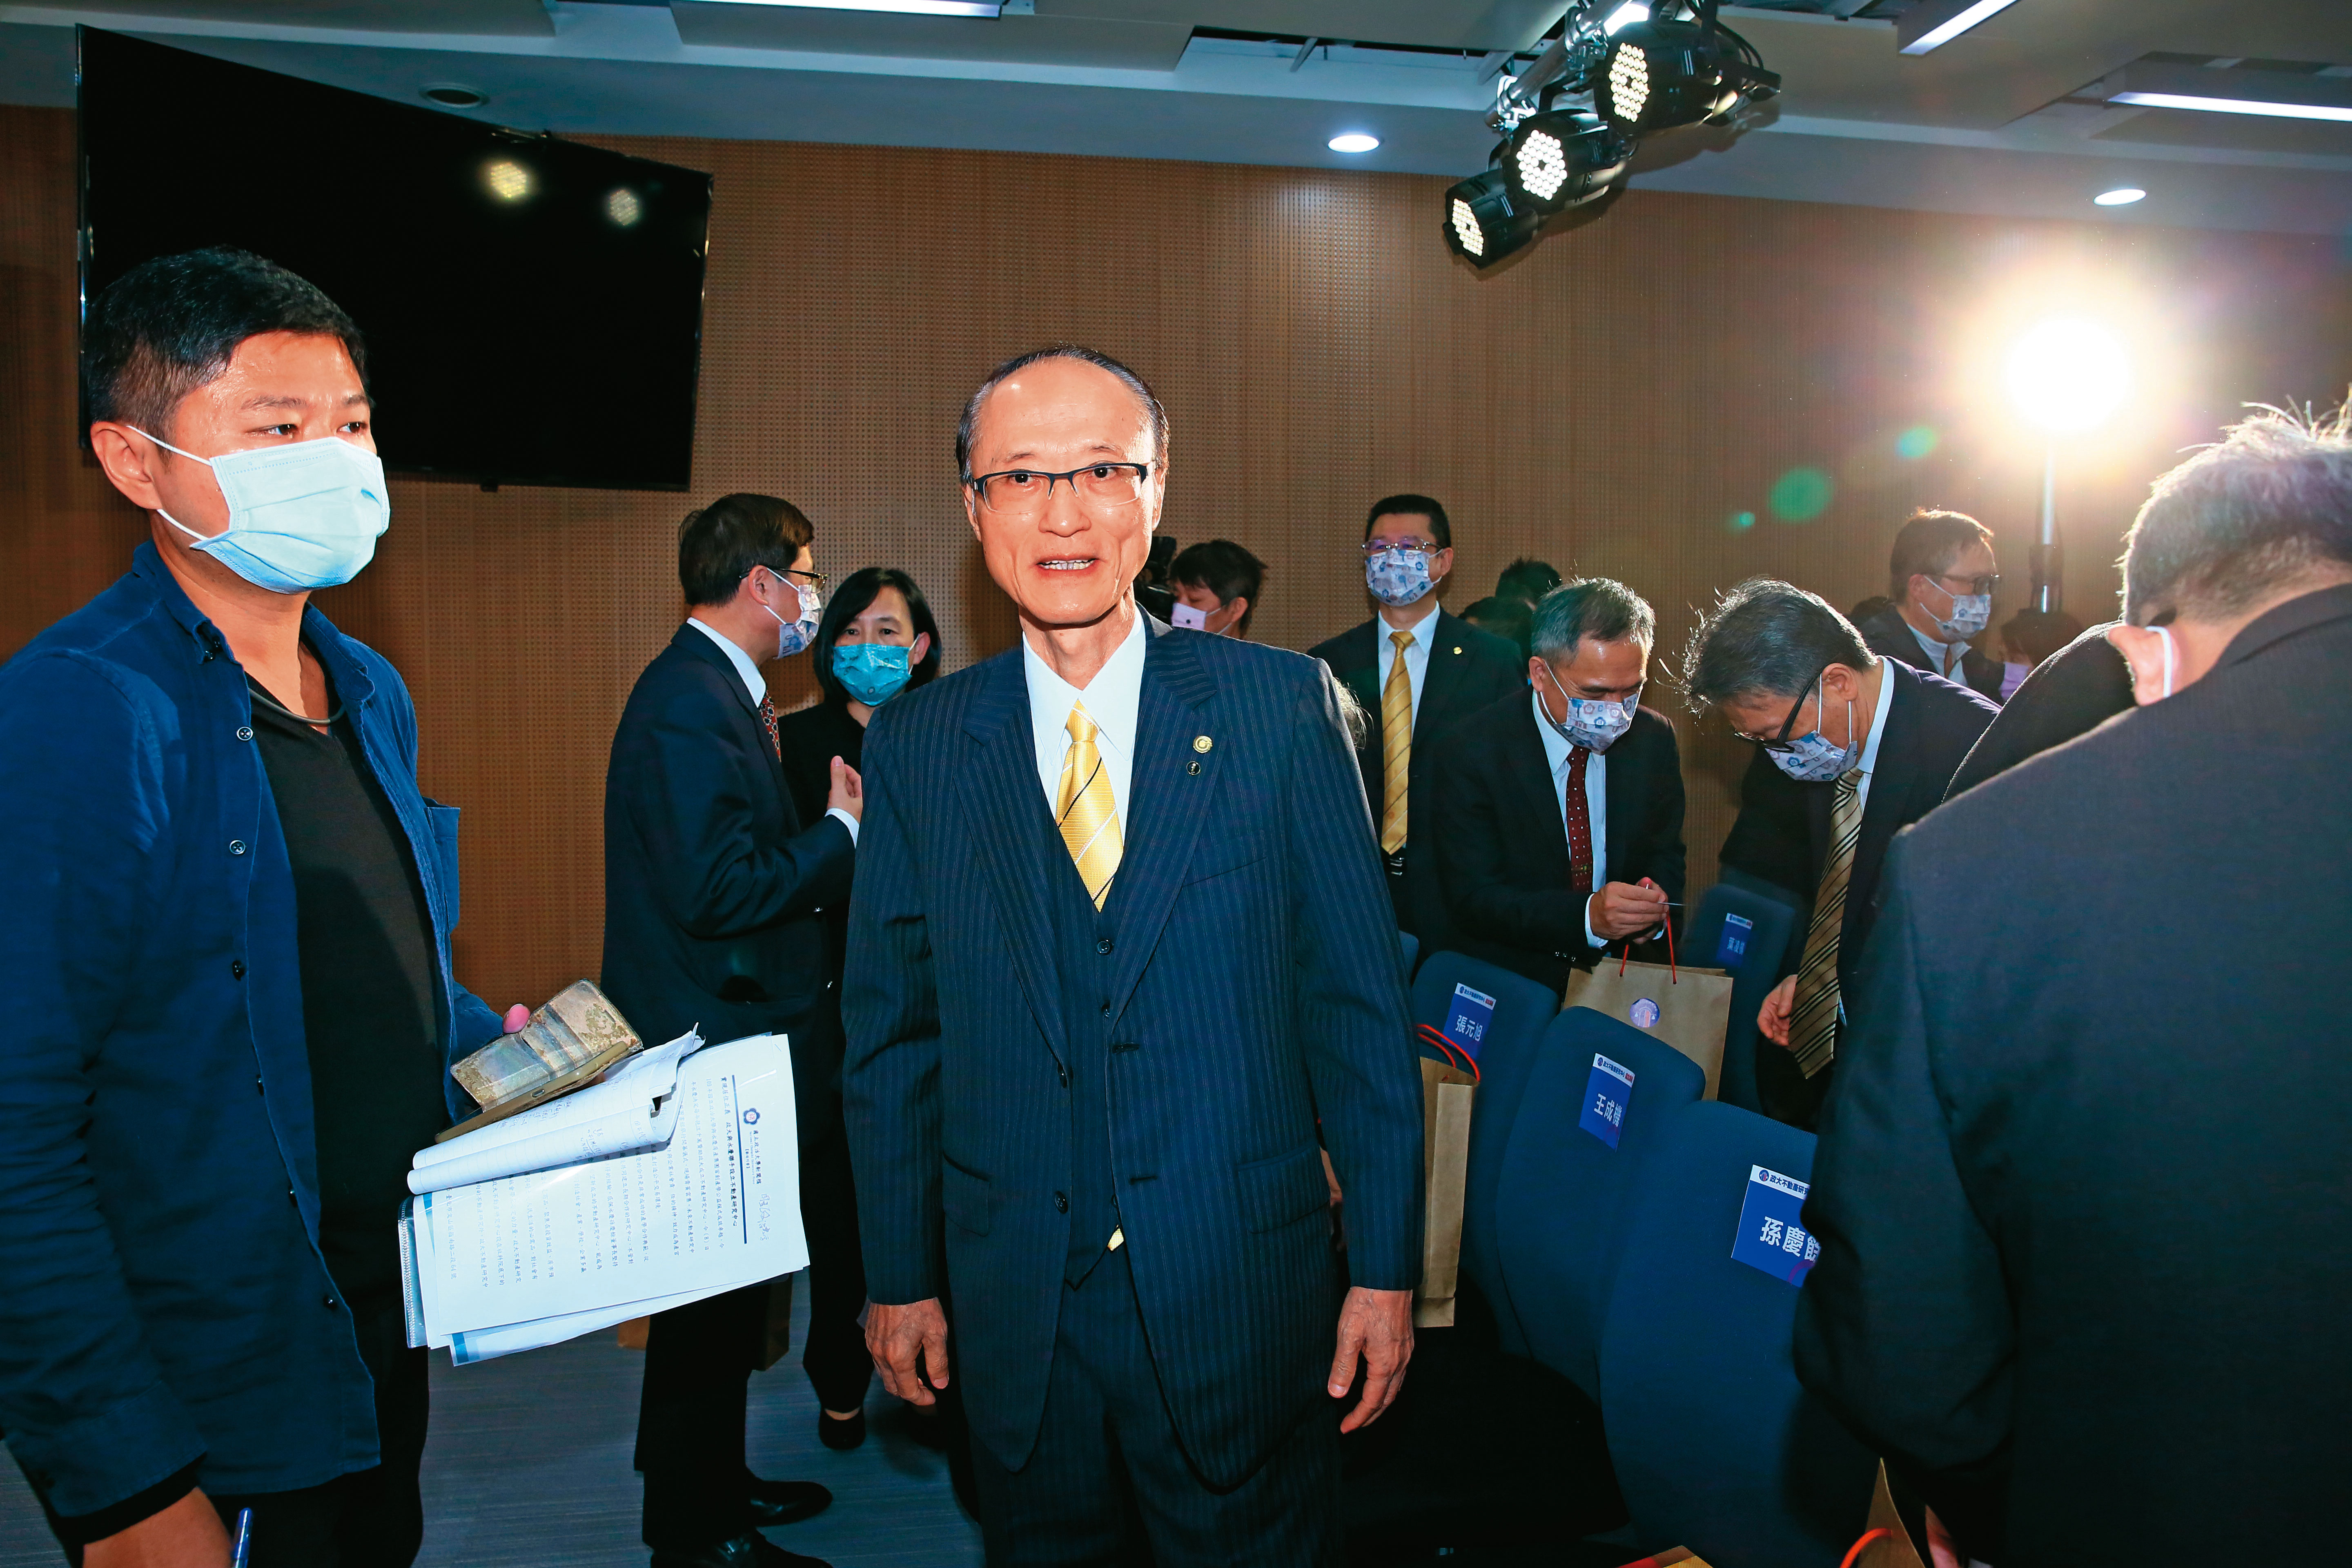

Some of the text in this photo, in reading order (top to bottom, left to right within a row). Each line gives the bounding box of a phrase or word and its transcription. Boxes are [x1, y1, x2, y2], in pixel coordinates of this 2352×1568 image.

[1455, 1014, 1483, 1042] 張元旭
[1594, 1093, 1622, 1127] 王成機
[720, 1076, 738, 1226] 實現居住正義 政大與永慶聯手設立不動產研究中心
[753, 1130, 762, 1184] 國立政治大學新聞稿
